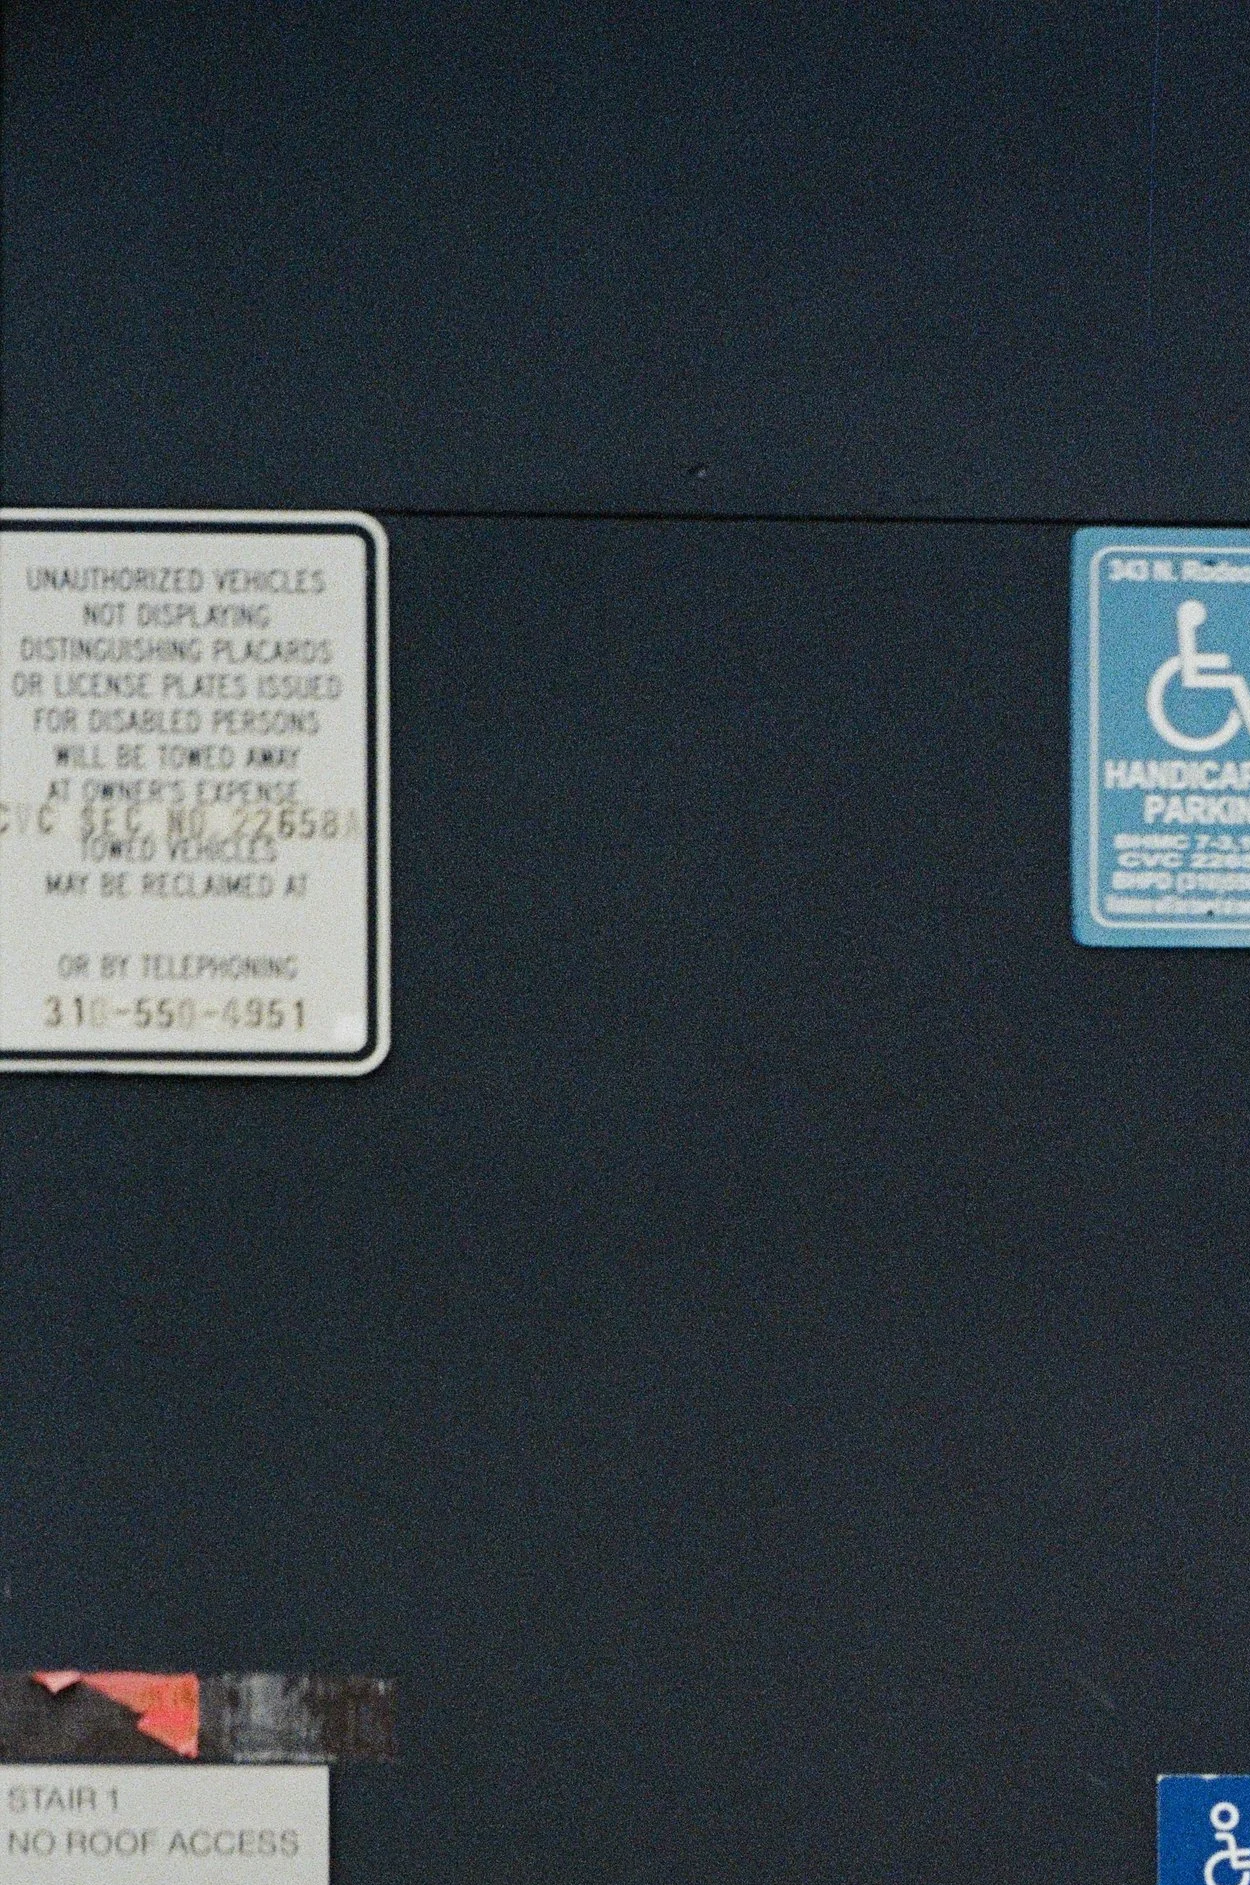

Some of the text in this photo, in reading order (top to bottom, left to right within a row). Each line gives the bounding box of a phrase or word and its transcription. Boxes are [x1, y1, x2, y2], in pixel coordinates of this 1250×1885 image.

[26, 568, 327, 594] UNAUTHORIZED VEHICLES
[83, 603, 271, 628] NOT DISPLAYING
[20, 637, 333, 664] DISTINGUISHING PLACARDS
[12, 672, 343, 700] OR LICENSE PLATES ISSUED
[33, 708, 321, 735] FOR DISABLED PERSONS
[54, 743, 301, 769] WILL BE TOWED AWAY
[48, 780, 300, 806] AT OWNER'S EXPENSE
[79, 836, 278, 864] TOWED VEHICLES
[1118, 852, 1184, 869] CVC
[45, 873, 310, 899] MAY BE RECLAIMED AT
[57, 954, 299, 980] OR BY TELEPHONING
[7, 1785, 120, 1813] STAIR 1
[7, 1829, 300, 1858] NO ROOF ACCESS
